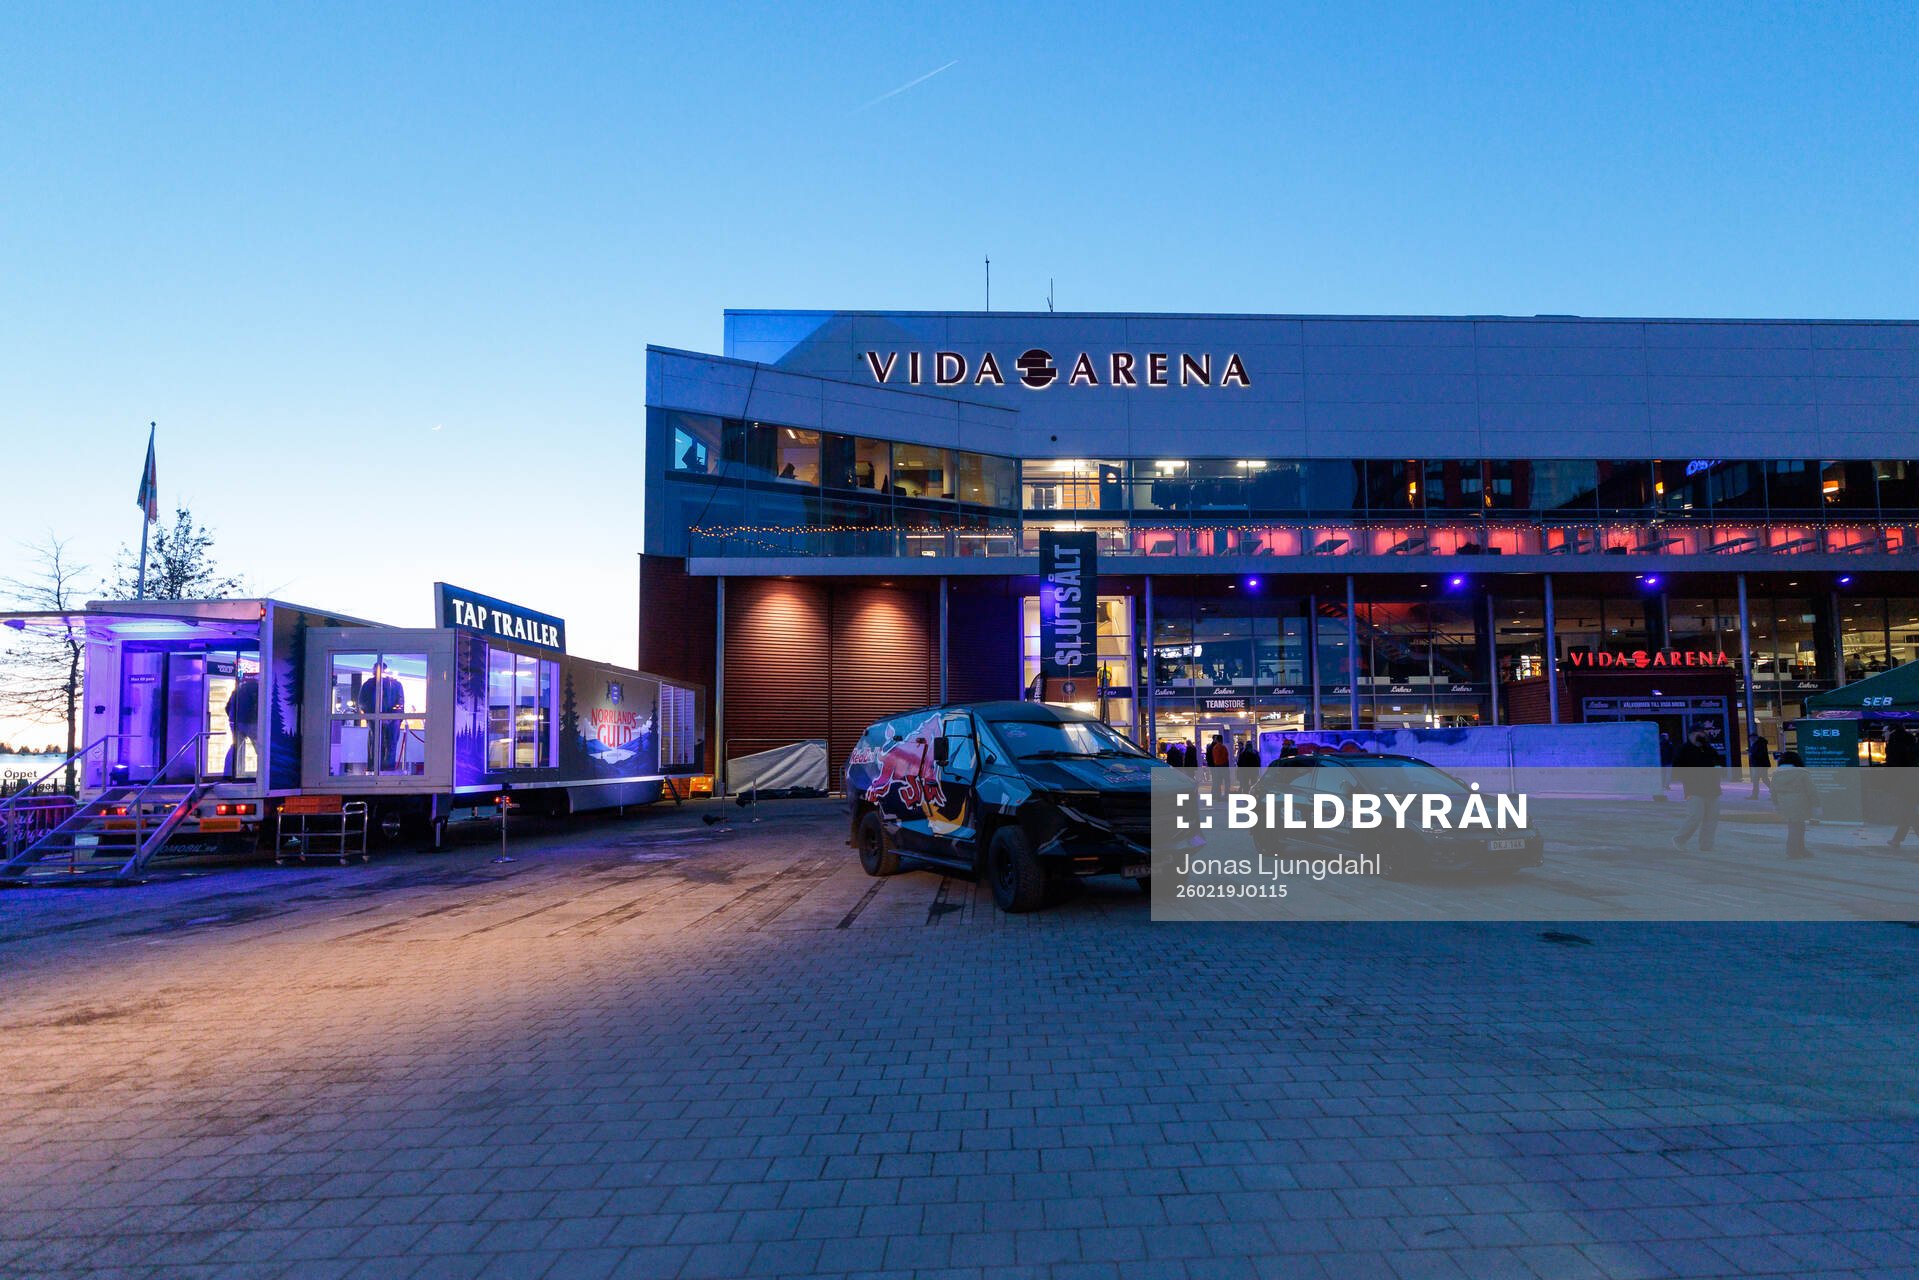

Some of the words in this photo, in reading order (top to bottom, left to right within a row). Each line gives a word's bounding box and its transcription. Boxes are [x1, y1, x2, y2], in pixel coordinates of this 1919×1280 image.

[865, 352, 1005, 386] VIDA
[1068, 352, 1251, 388] ARENA
[1048, 544, 1082, 666] SLUTSÅLT
[452, 598, 487, 630] TAP
[491, 609, 560, 649] TRAILER
[1570, 651, 1628, 667] VIDA
[1653, 651, 1729, 667] ARENA
[1206, 699, 1245, 709] TEAMSTORE
[590, 707, 637, 729] NORRLANDS
[596, 723, 632, 748] GULD
[4, 767, 38, 780] Öppet
